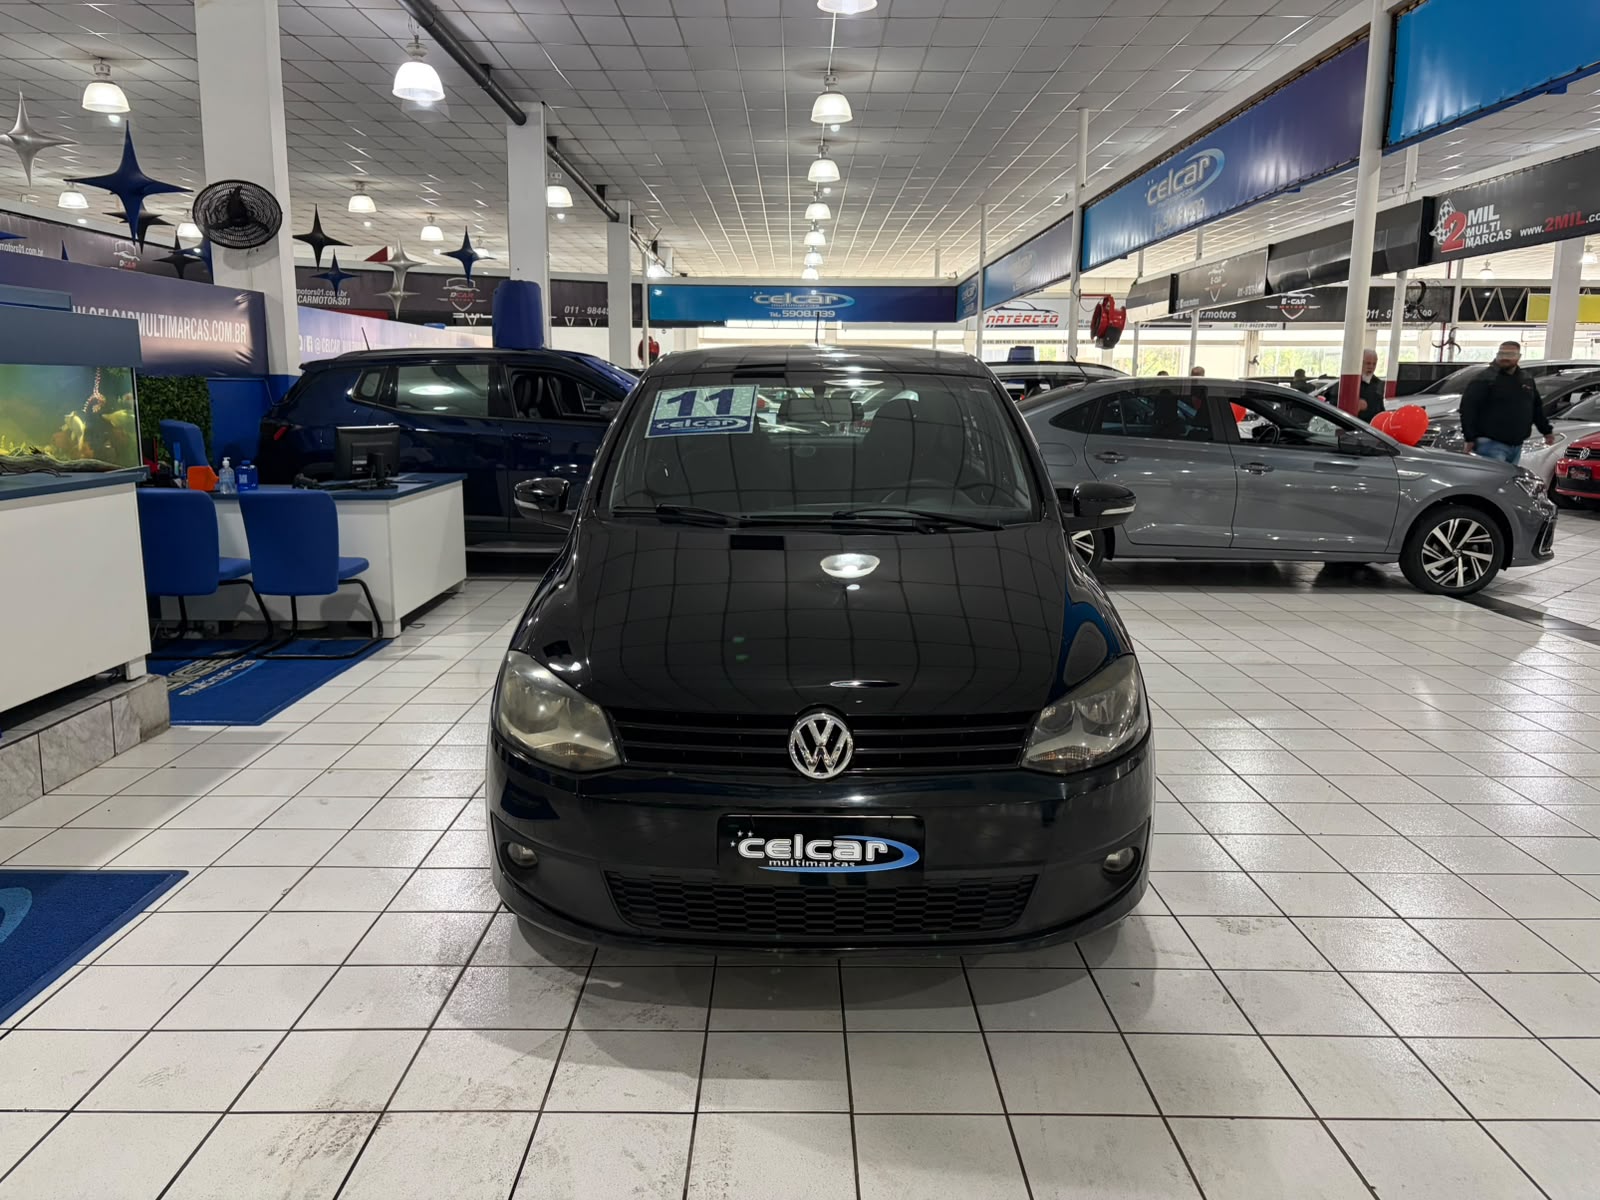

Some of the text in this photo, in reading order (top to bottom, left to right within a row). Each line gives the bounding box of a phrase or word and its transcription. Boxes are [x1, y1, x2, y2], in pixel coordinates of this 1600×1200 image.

[1146, 156, 1211, 207] celcar
[1440, 204, 1500, 253] 2 MIL
[1466, 220, 1501, 237] MULTI
[1465, 229, 1512, 248] MARCAS
[753, 292, 839, 305] celcar
[564, 305, 579, 314] 011
[667, 388, 735, 417] 11
[655, 419, 732, 430] celcar
[737, 834, 889, 862] celcar
[768, 858, 856, 868] multimarcas
